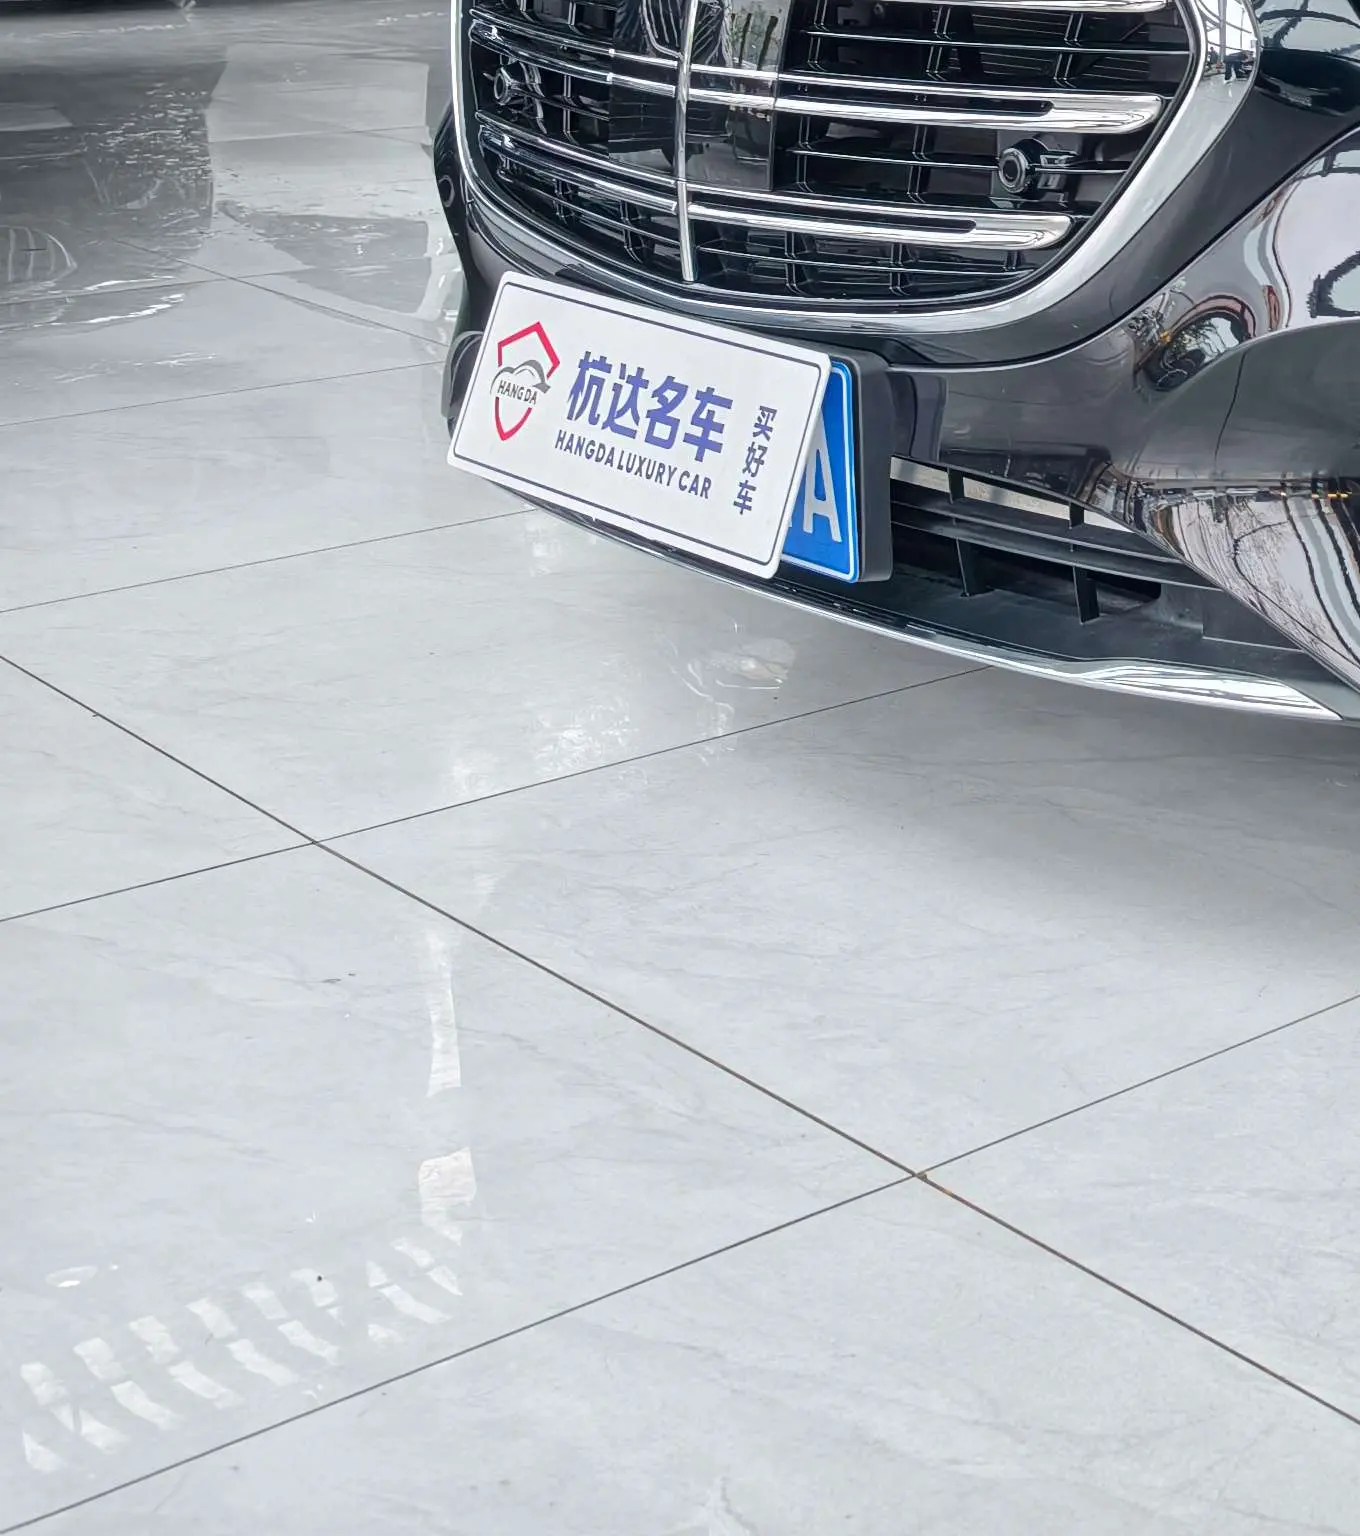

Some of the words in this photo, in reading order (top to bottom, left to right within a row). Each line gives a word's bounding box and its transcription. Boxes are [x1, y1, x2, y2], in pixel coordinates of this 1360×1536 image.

[567, 351, 733, 462] 杭达名车
[732, 405, 779, 515] 买好车
[555, 429, 614, 469] HANGDA
[617, 450, 676, 486] LUXURY
[678, 471, 711, 500] CAR
